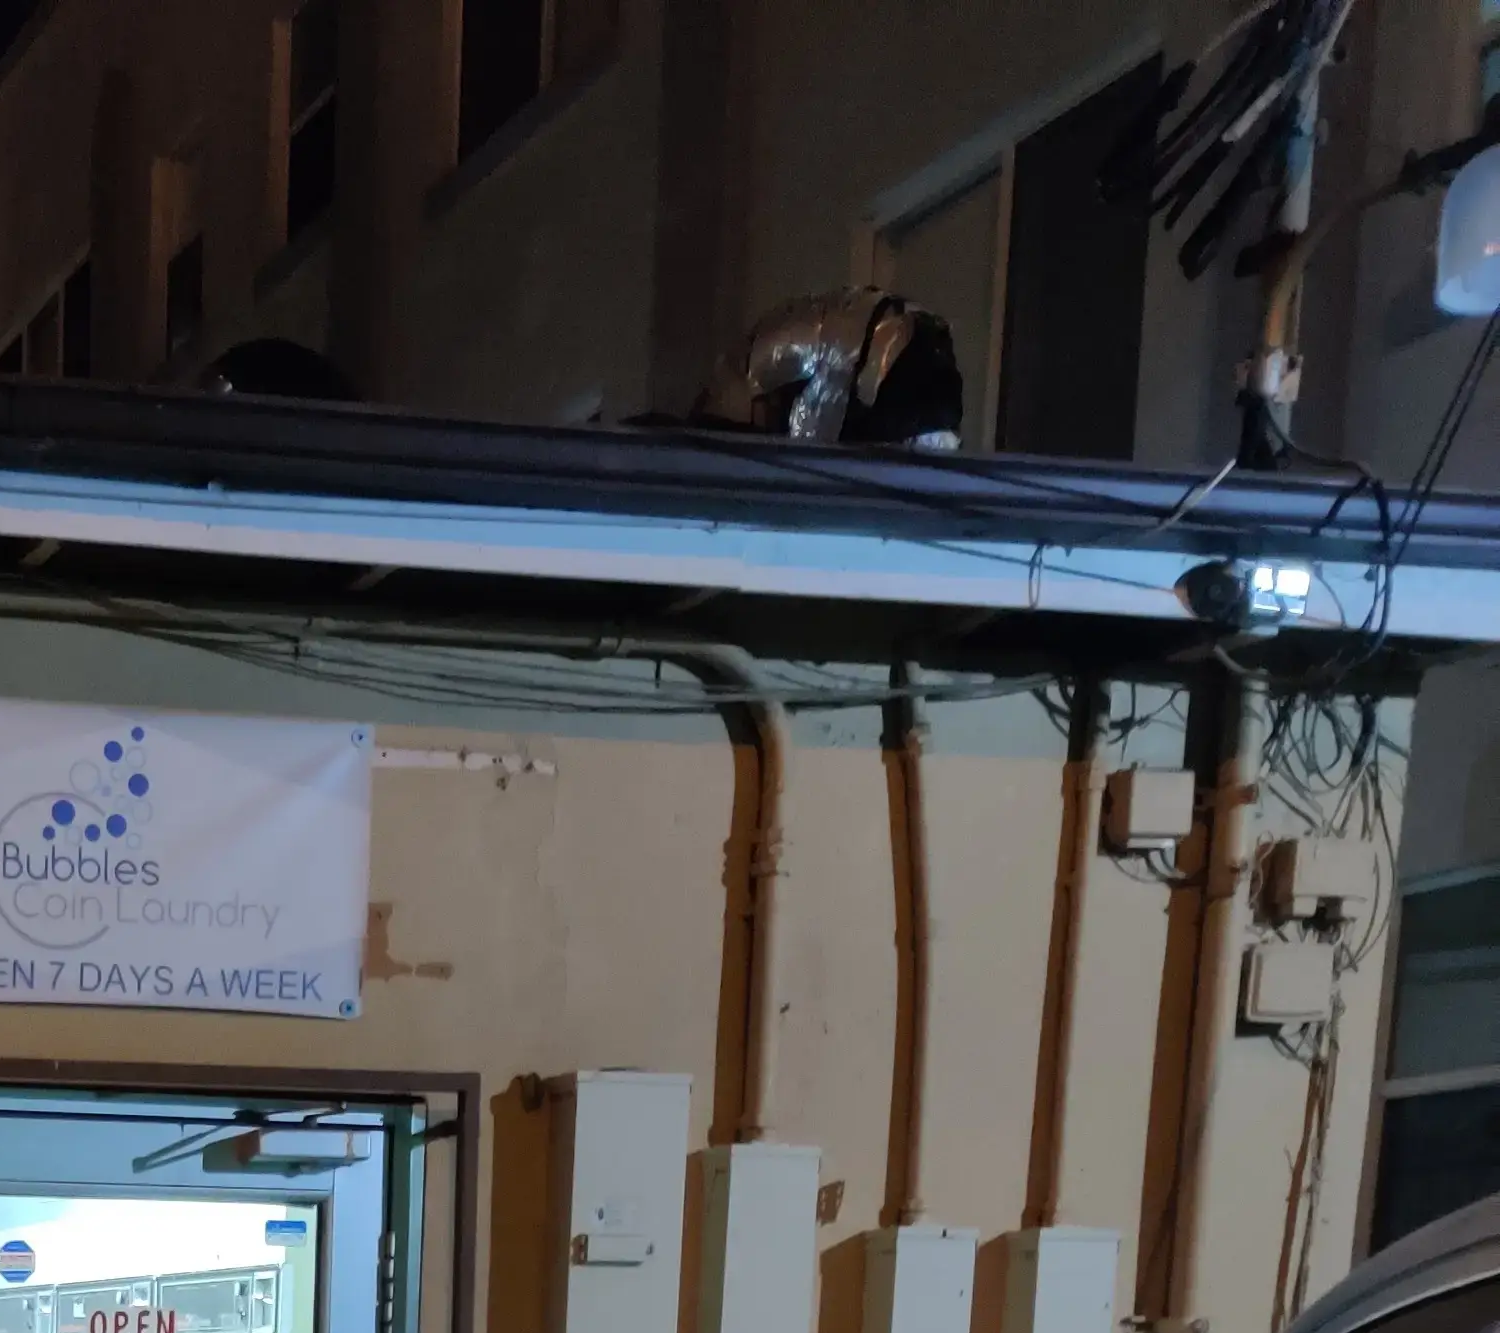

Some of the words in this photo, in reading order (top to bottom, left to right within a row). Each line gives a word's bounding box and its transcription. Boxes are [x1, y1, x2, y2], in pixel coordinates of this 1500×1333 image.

[2, 842, 160, 886] Bubbles
[12, 881, 103, 921] Coin
[116, 886, 282, 940] Laundry
[49, 961, 65, 989] 7
[80, 963, 174, 997] DAYS
[186, 967, 209, 998] A
[220, 968, 323, 1003] WEEK
